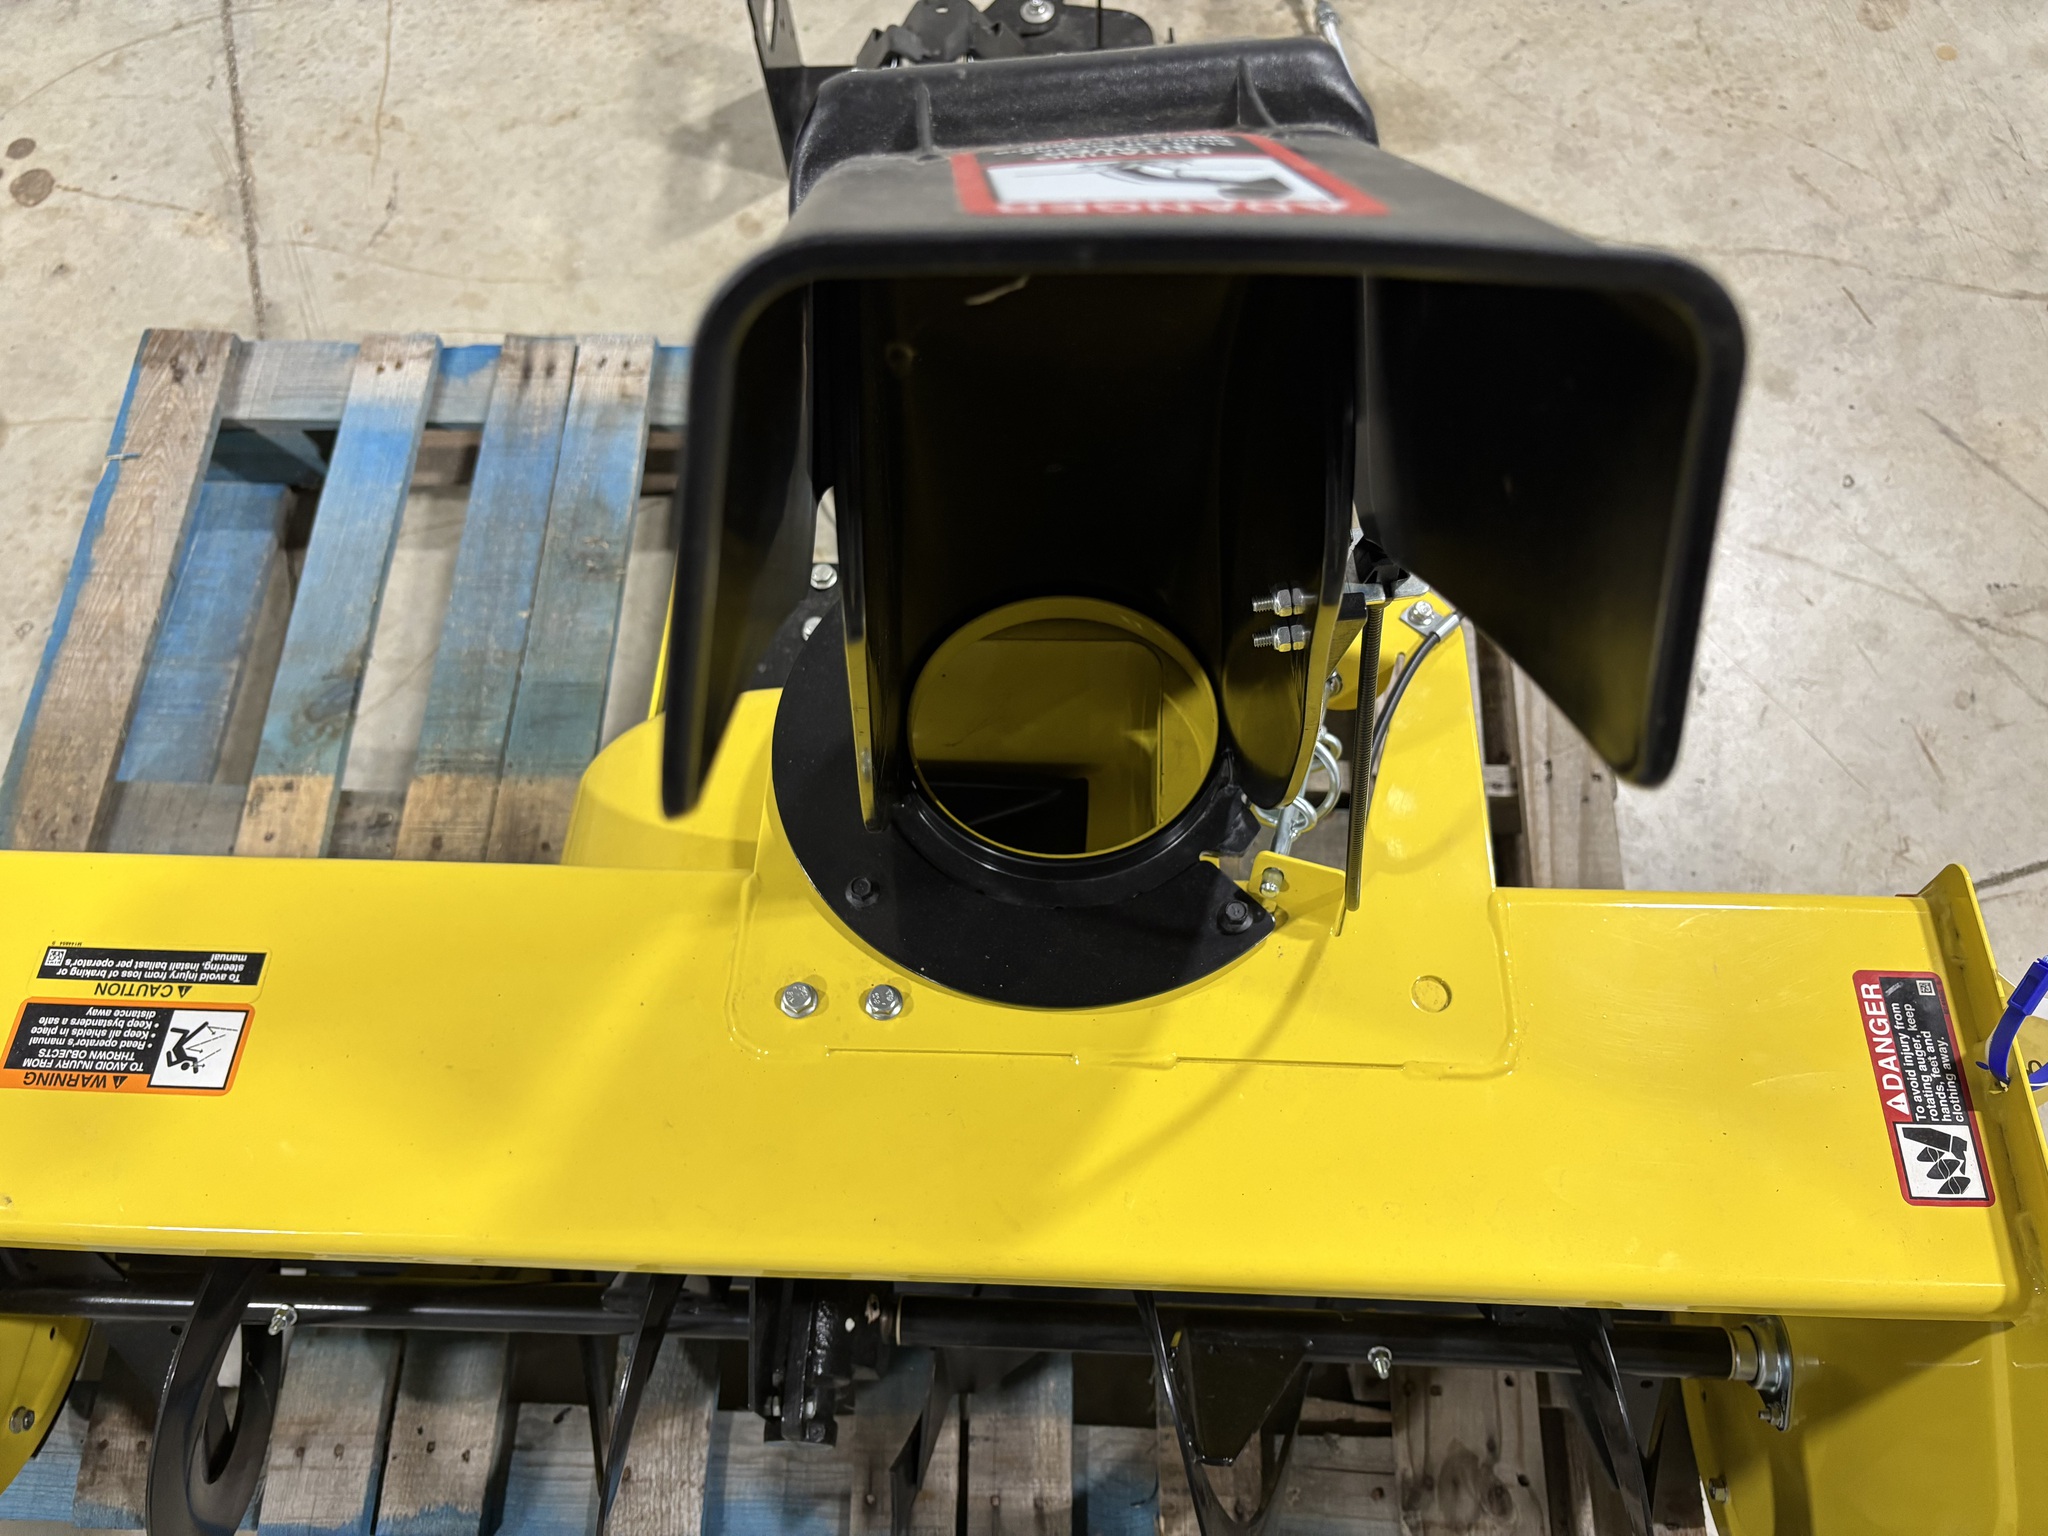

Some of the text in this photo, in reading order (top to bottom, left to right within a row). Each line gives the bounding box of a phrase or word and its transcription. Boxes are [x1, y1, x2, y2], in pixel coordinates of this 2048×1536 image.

[65, 958, 244, 973] steering, install ballast per operator's
[70, 967, 106, 978] braking
[108, 970, 118, 978] of
[121, 970, 141, 978] loss
[143, 971, 167, 979] from
[168, 971, 197, 981] injury
[200, 973, 227, 981] avoid
[229, 974, 240, 982] To
[94, 983, 173, 997] CAUTION
[86, 1007, 156, 1018] distance away
[71, 1017, 125, 1028] bystanders
[127, 1021, 152, 1029] Keep
[31, 1026, 58, 1034] place
[72, 1028, 107, 1037] shields
[109, 1029, 122, 1037] all
[124, 1030, 149, 1039] Keep
[1861, 984, 1903, 1090] DANGER
[29, 1037, 145, 1049] Read operator's manual
[38, 1049, 135, 1060] THROWN OBJECTS
[23, 1058, 144, 1071] TO AVOID INJURY FROM
[1891, 1002, 1926, 1121] To avoid injury from
[1904, 1004, 1939, 1121] rotating auger, keep
[23, 1072, 107, 1088] WARNING
[1921, 1031, 1952, 1121] hands, feet and
[1937, 1037, 1964, 1122] clothing away.
